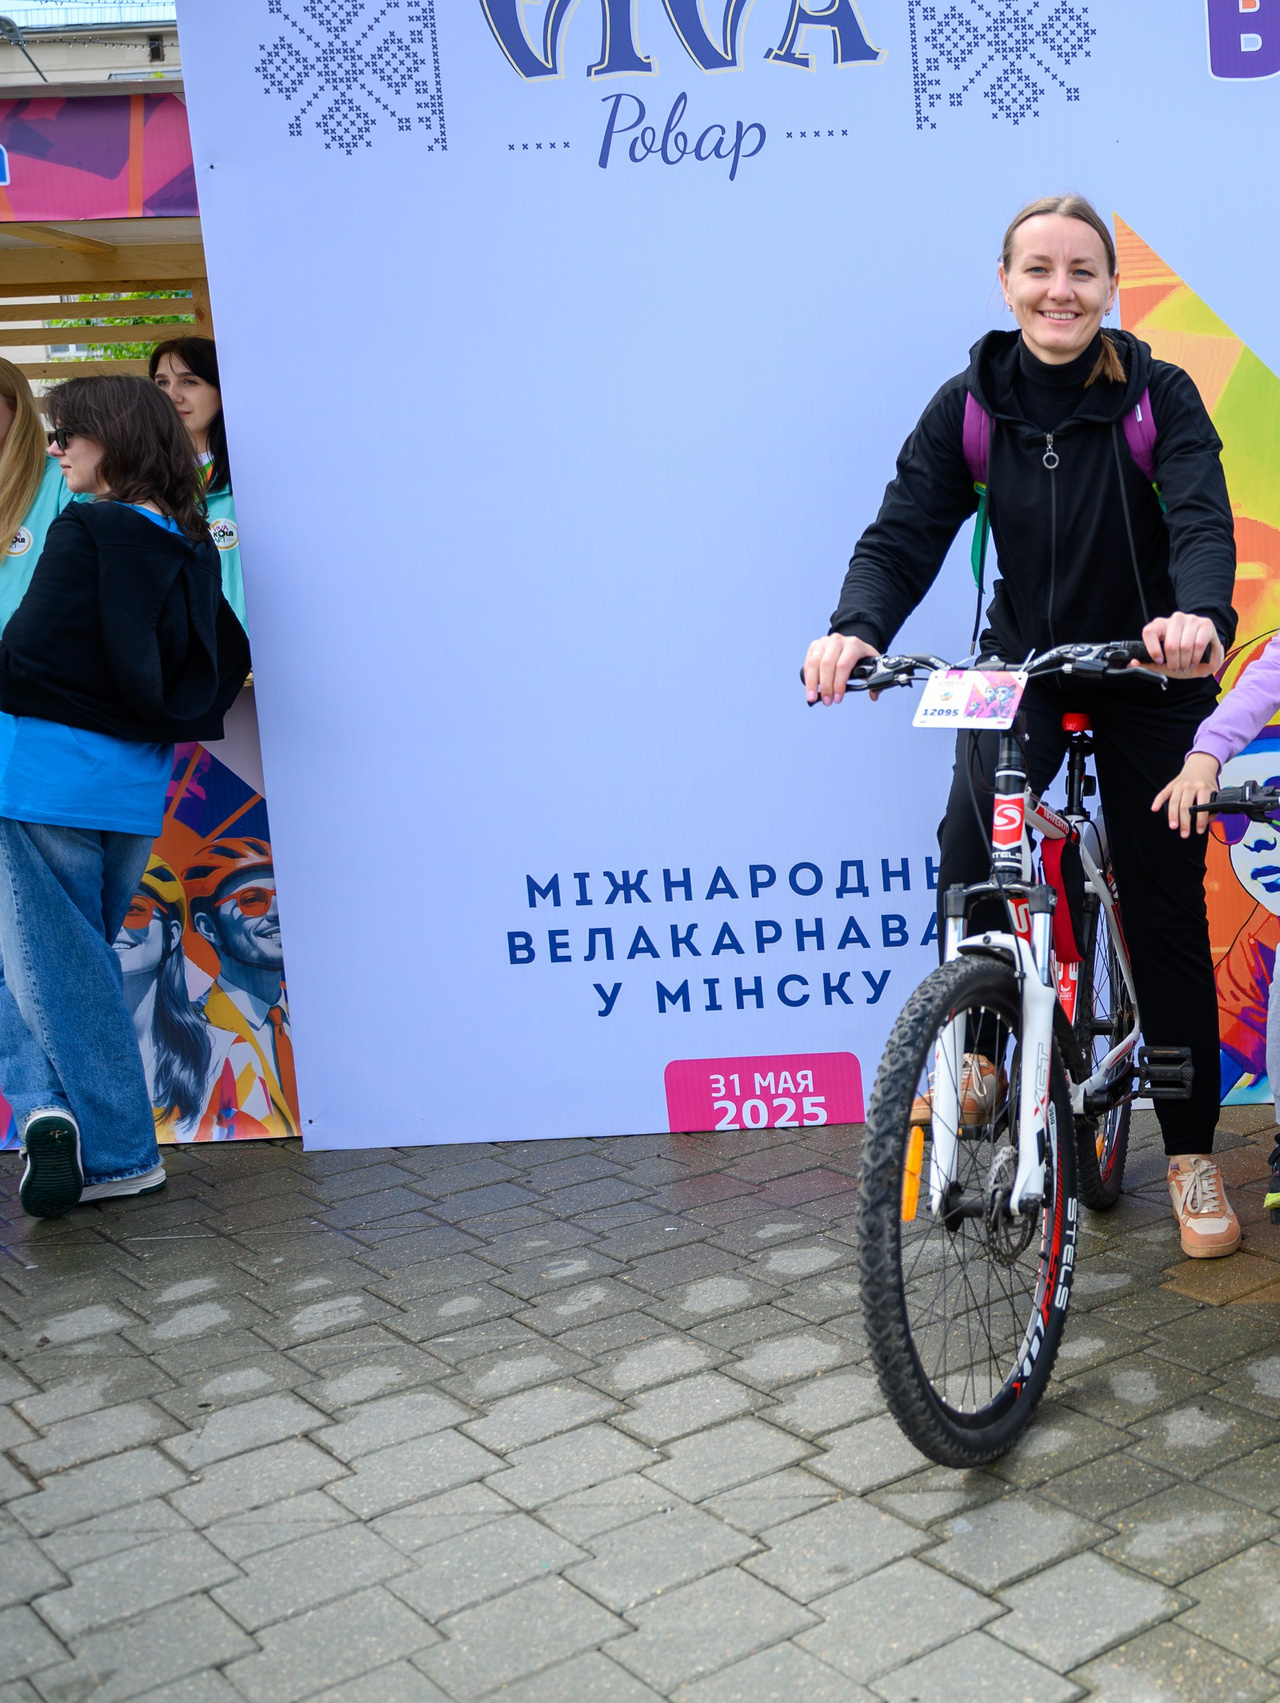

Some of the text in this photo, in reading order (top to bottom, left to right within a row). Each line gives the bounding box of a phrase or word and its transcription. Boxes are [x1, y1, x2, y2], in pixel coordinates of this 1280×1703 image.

[598, 91, 766, 181] Ровар
[922, 708, 960, 717] 12095
[506, 911, 940, 965] ВЕЛАКАРНАВА
[592, 969, 892, 1017] У МІНСКУ
[709, 1069, 815, 1098] 31 МАЯ
[712, 1095, 828, 1131] 2025
[1053, 1196, 1079, 1312] STELS
